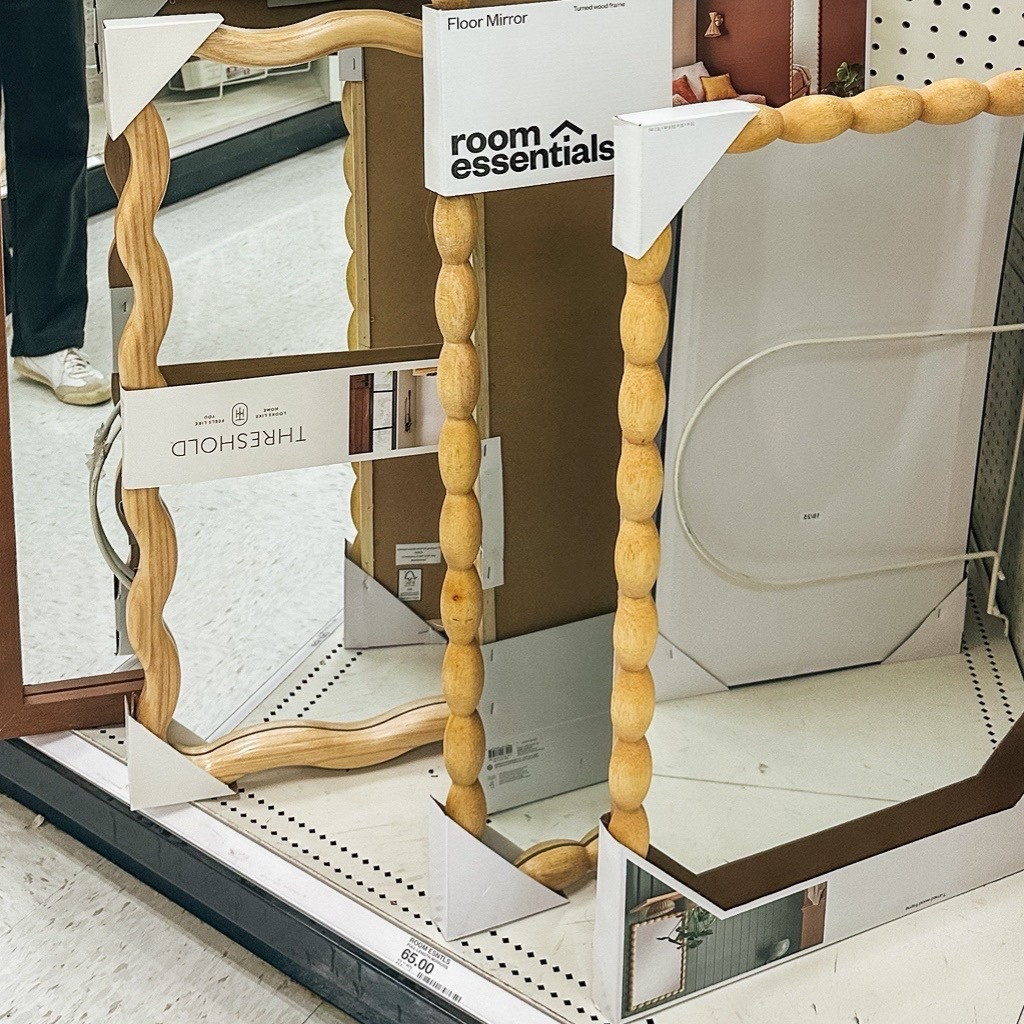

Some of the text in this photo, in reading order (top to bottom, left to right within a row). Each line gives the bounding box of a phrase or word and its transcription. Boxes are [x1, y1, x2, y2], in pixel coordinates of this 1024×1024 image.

[447, 13, 528, 31] Floor Mirror
[451, 126, 541, 156] room
[451, 133, 615, 179] essentials
[171, 426, 307, 457] THRESHOLD
[401, 948, 435, 974] 65.00
[409, 937, 428, 951] ROOM
[427, 946, 452, 965] ESNTLS
